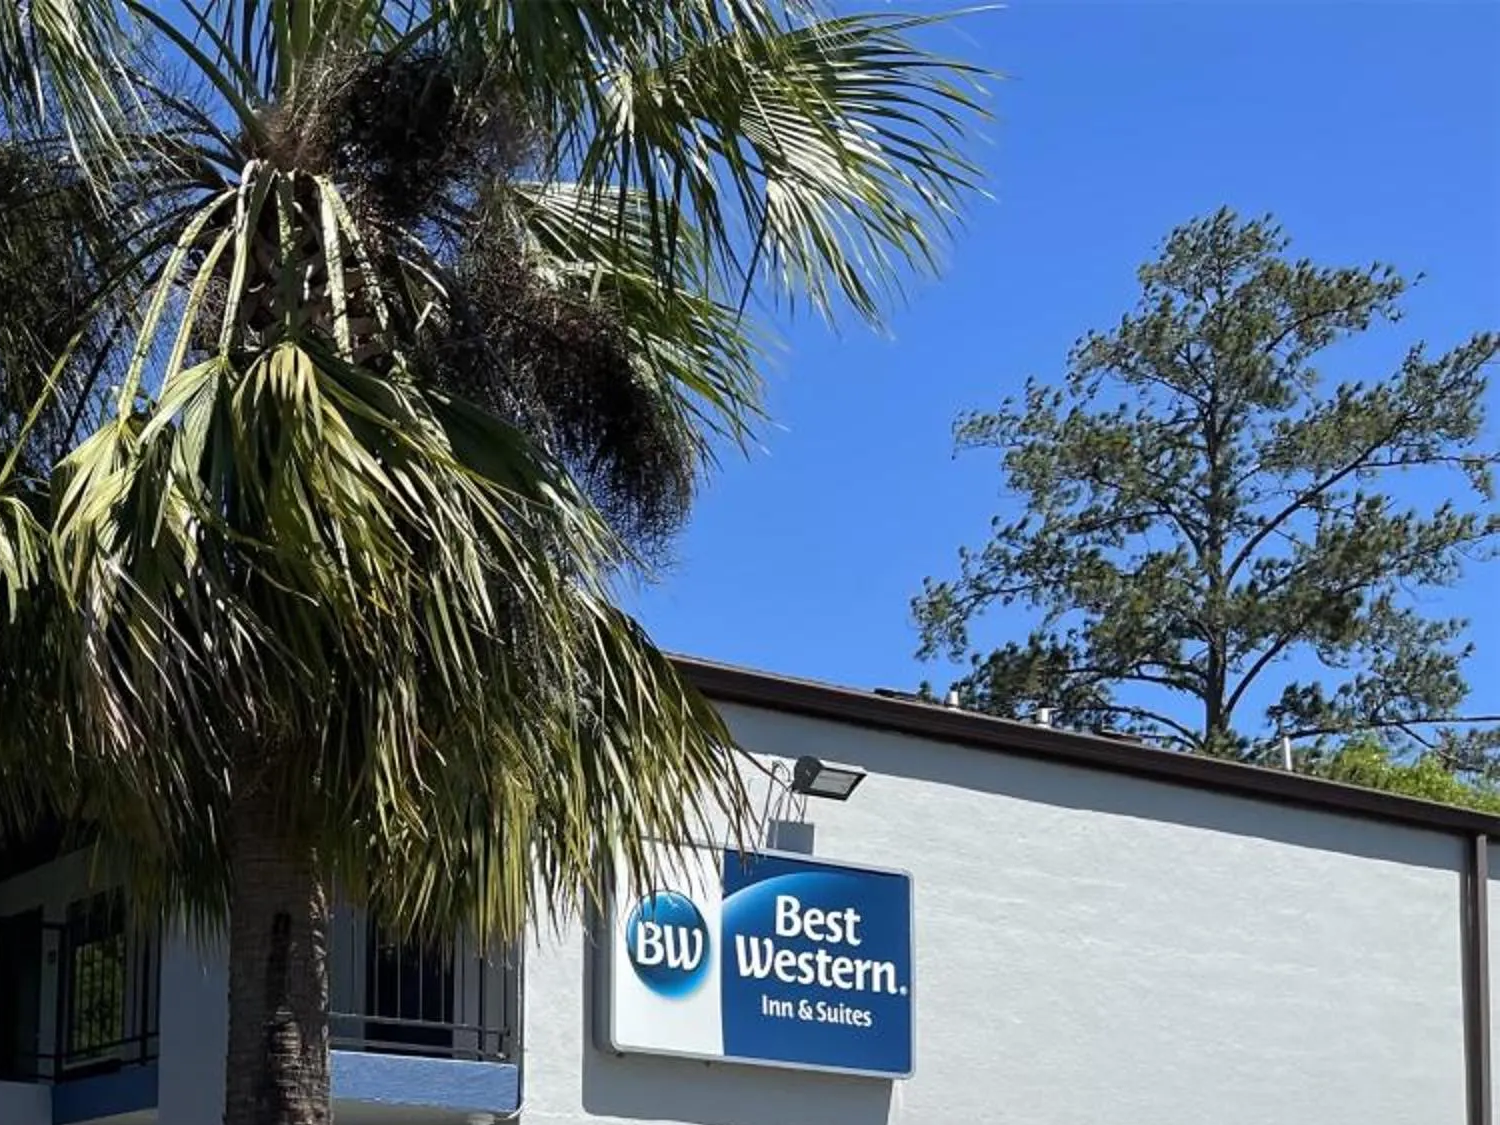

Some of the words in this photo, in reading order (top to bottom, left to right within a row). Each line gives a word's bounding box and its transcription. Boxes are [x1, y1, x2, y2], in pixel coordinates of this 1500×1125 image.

[775, 895, 861, 946] Best
[636, 921, 704, 971] BW
[762, 994, 794, 1019] Inn
[798, 999, 814, 1021] &
[817, 1001, 872, 1027] Suites
